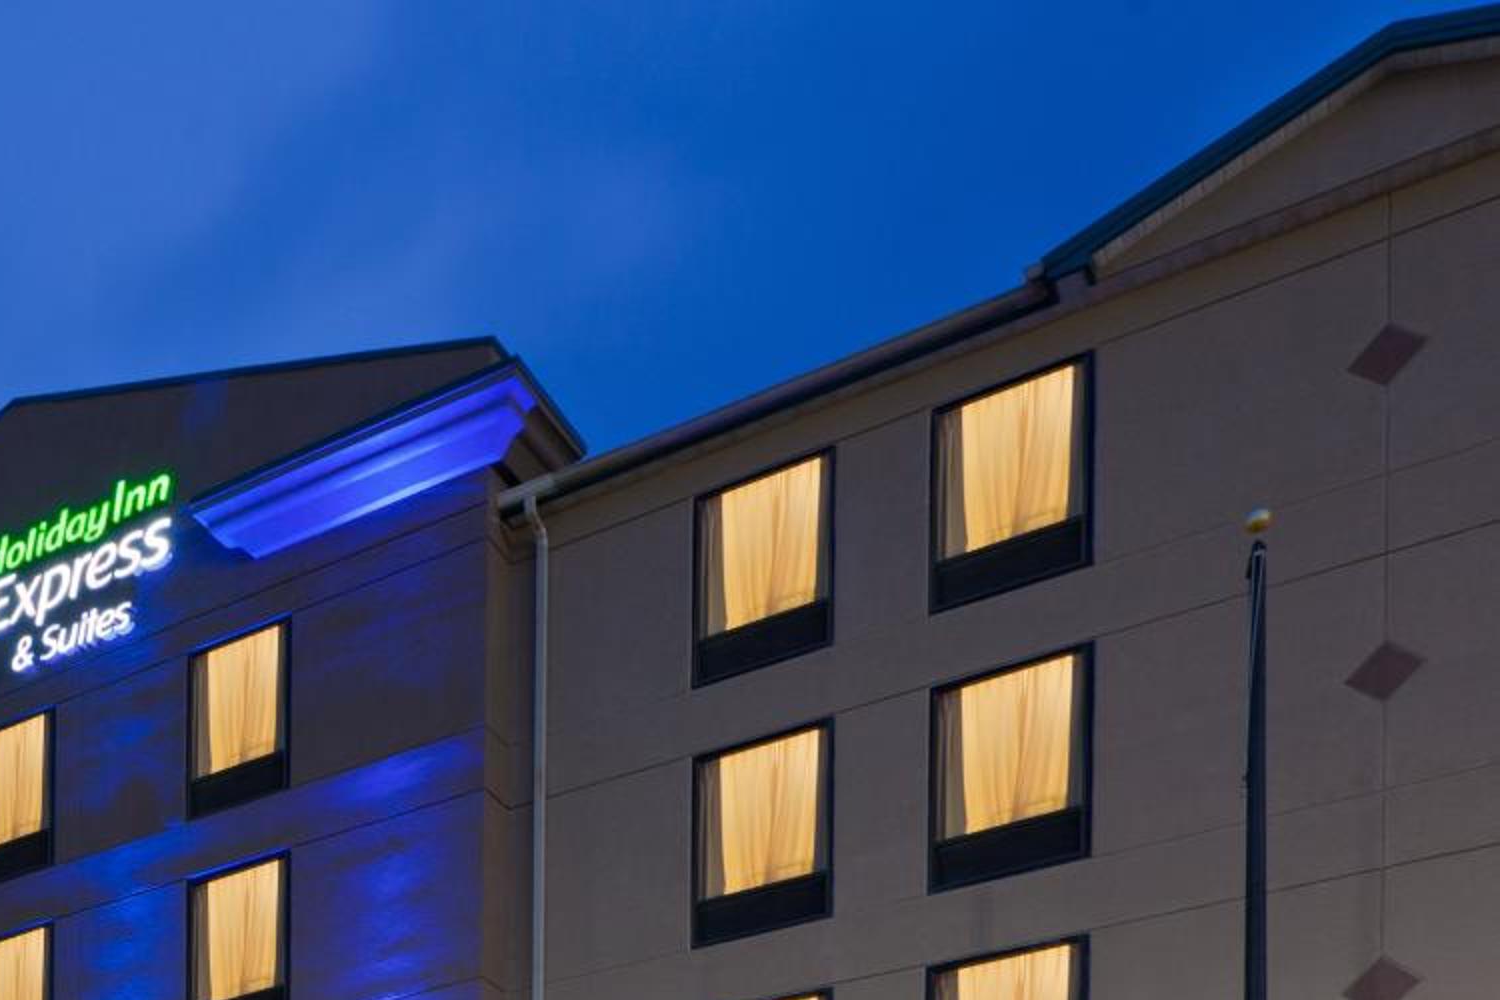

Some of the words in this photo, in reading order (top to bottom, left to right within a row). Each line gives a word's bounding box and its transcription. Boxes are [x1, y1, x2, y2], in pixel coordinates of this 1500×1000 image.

[113, 473, 171, 523] Inn
[11, 635, 34, 673] &
[40, 601, 133, 660] Suites
